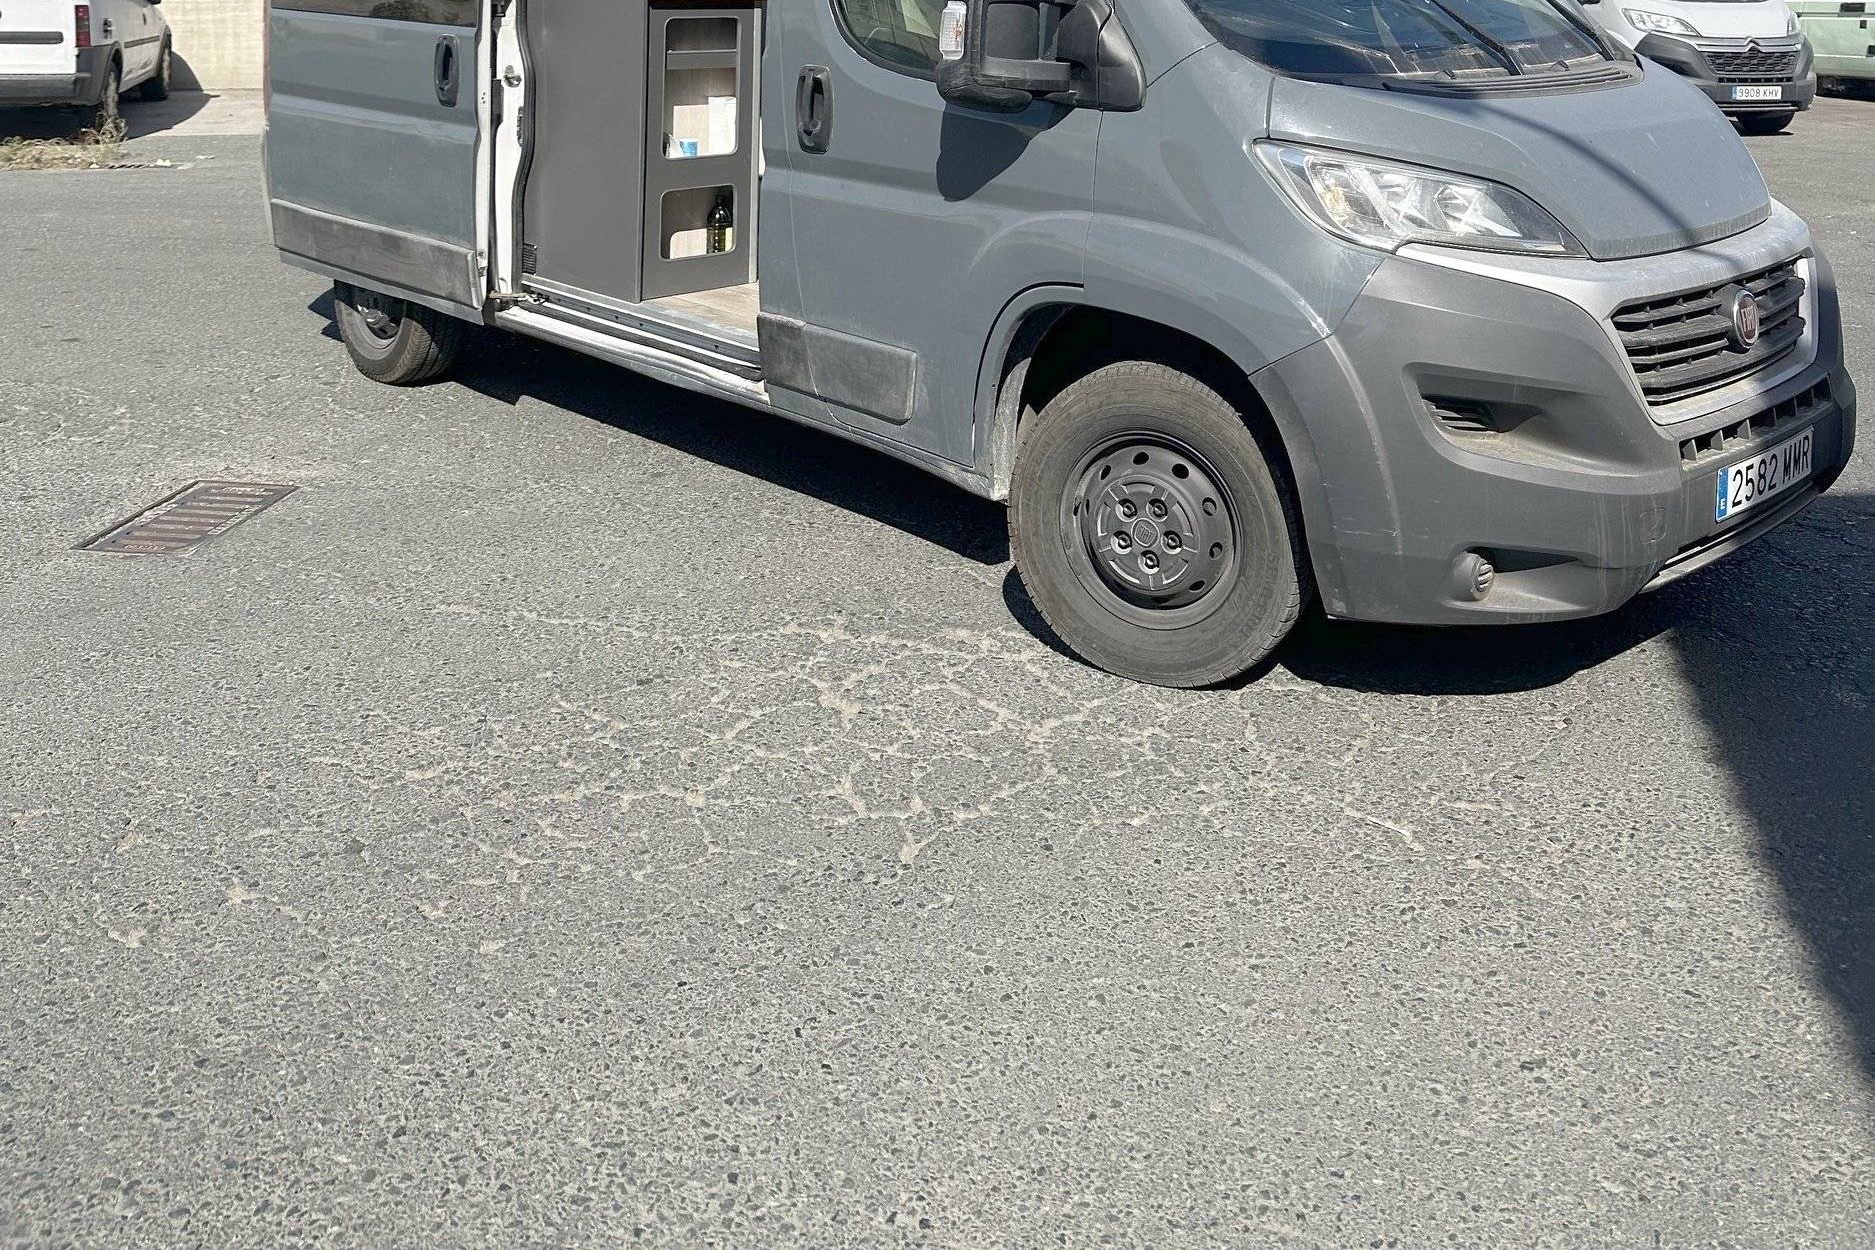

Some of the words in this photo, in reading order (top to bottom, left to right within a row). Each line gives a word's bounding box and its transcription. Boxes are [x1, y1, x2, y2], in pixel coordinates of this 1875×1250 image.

[1720, 498, 1726, 510] E
[1731, 453, 1778, 509] 2582
[1782, 435, 1810, 485] MMR
